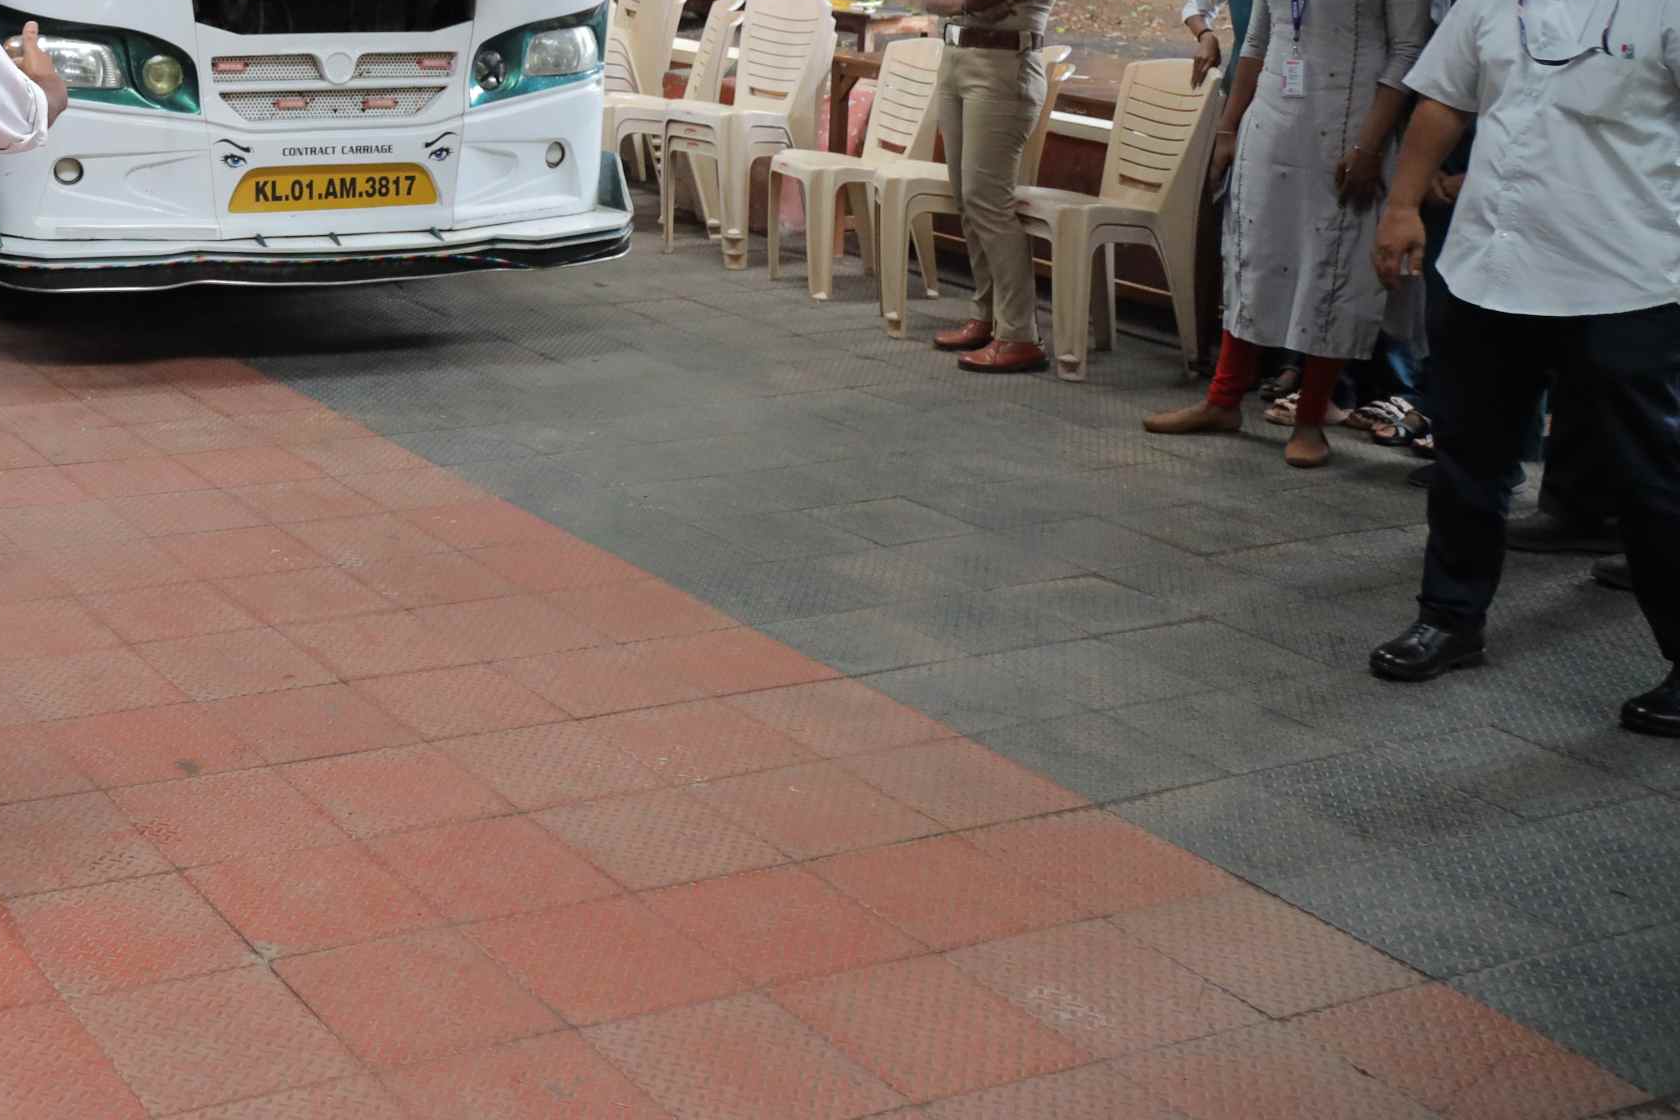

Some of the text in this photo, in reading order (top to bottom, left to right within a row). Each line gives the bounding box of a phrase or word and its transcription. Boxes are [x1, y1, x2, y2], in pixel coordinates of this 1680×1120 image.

[282, 144, 393, 157] CONTRACT CARRIAGE
[254, 175, 417, 203] KL.01.AM.3817
